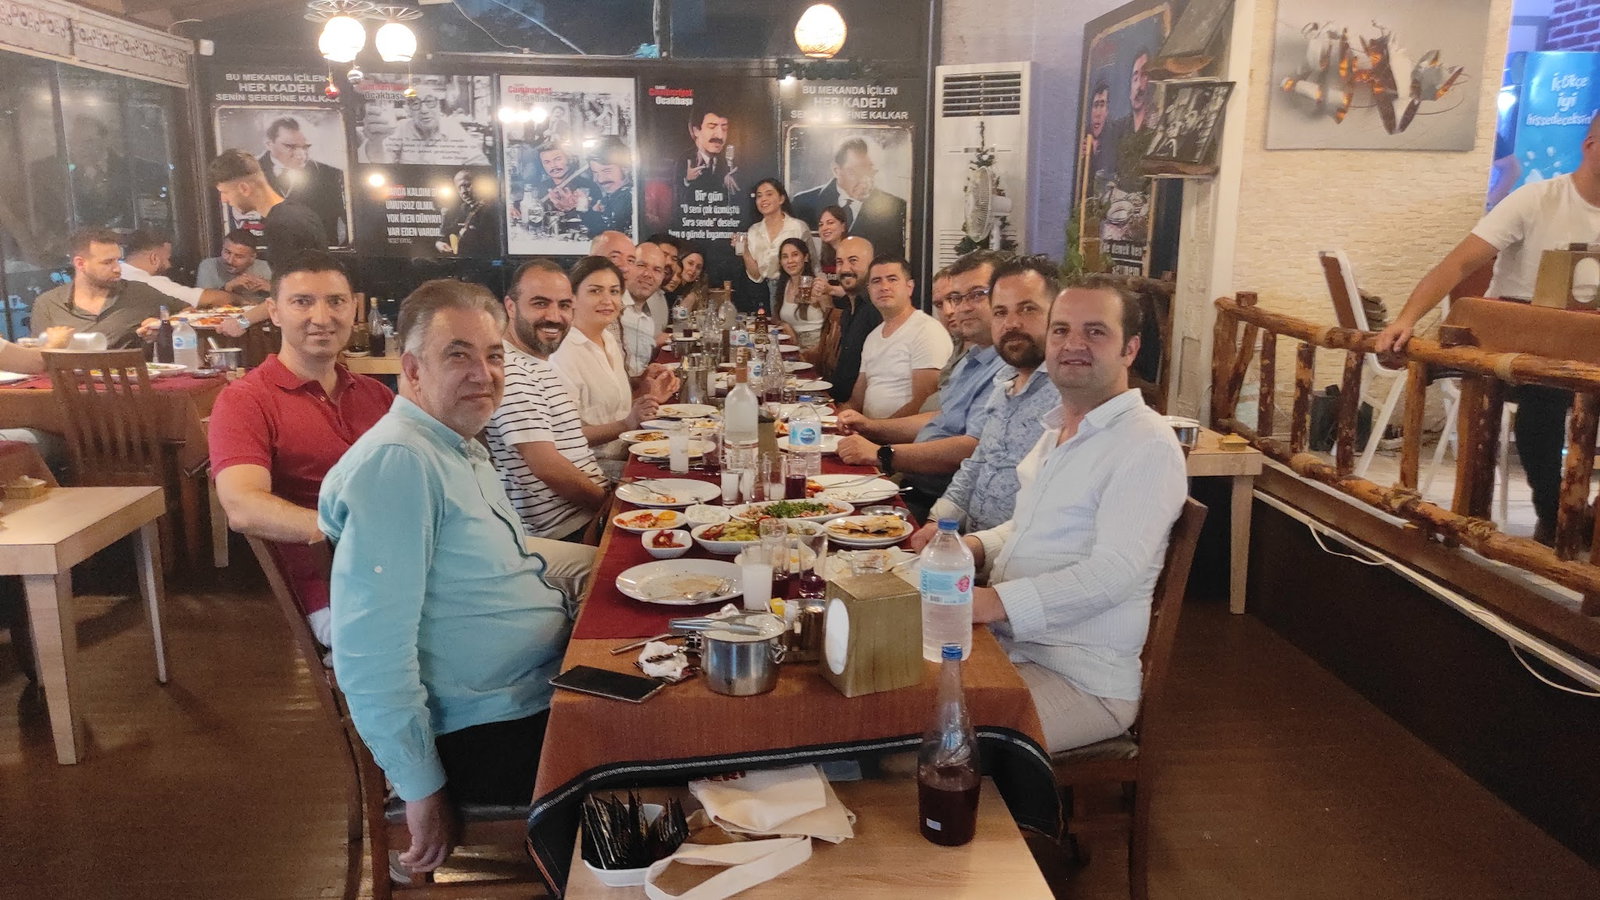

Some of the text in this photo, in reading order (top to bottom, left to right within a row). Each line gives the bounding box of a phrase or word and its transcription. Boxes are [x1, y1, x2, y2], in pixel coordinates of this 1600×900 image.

[226, 73, 240, 81] BU
[242, 73, 293, 82] MEKANDA
[239, 83, 316, 93] HER KADEH
[802, 84, 898, 96] BU MEKANDA İÇİLEN
[215, 93, 246, 101] SENİN
[842, 97, 887, 108] KADEH
[869, 111, 909, 120] KALKAR
[694, 189, 723, 203] Bir gün
[689, 204, 702, 214] seni
[386, 213, 400, 223] YOK
[387, 227, 400, 236] VAR
